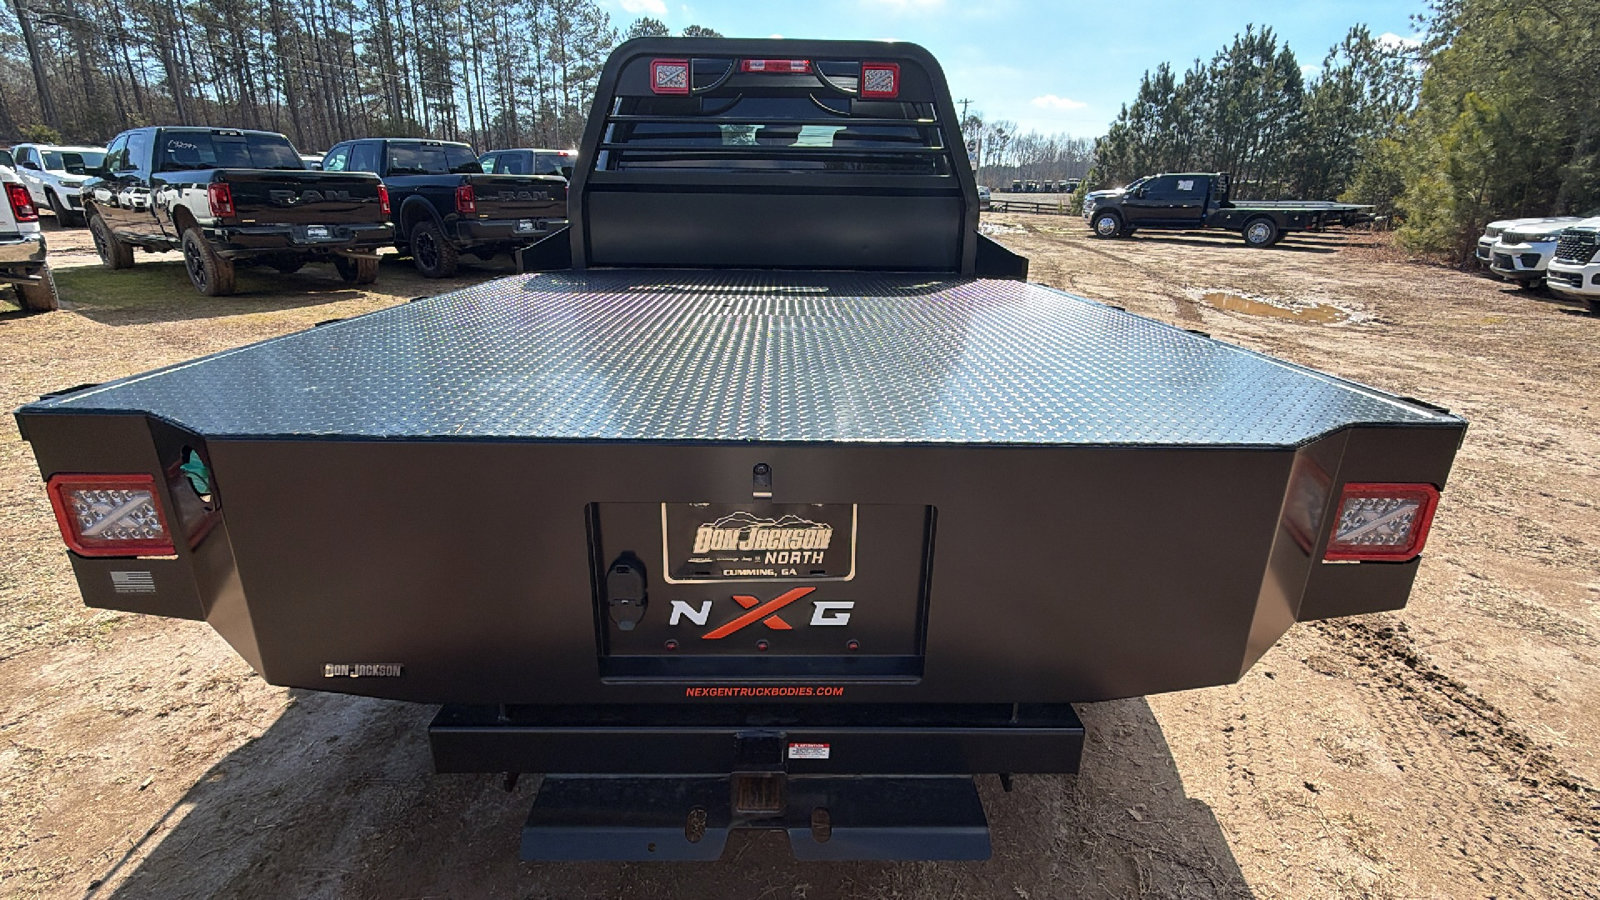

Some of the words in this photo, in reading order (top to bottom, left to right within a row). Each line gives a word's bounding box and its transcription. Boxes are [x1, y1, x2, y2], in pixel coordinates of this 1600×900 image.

[269, 189, 350, 205] RAM
[498, 191, 548, 202] RAM
[739, 526, 834, 551] JACKSON
[764, 551, 824, 565] NORTH
[723, 568, 778, 577] CUMMING,
[781, 568, 798, 576] GA
[324, 663, 349, 677] DON
[349, 663, 402, 677] JACKSON
[686, 686, 844, 697] NEXGENTRUCKBODIES.COM
